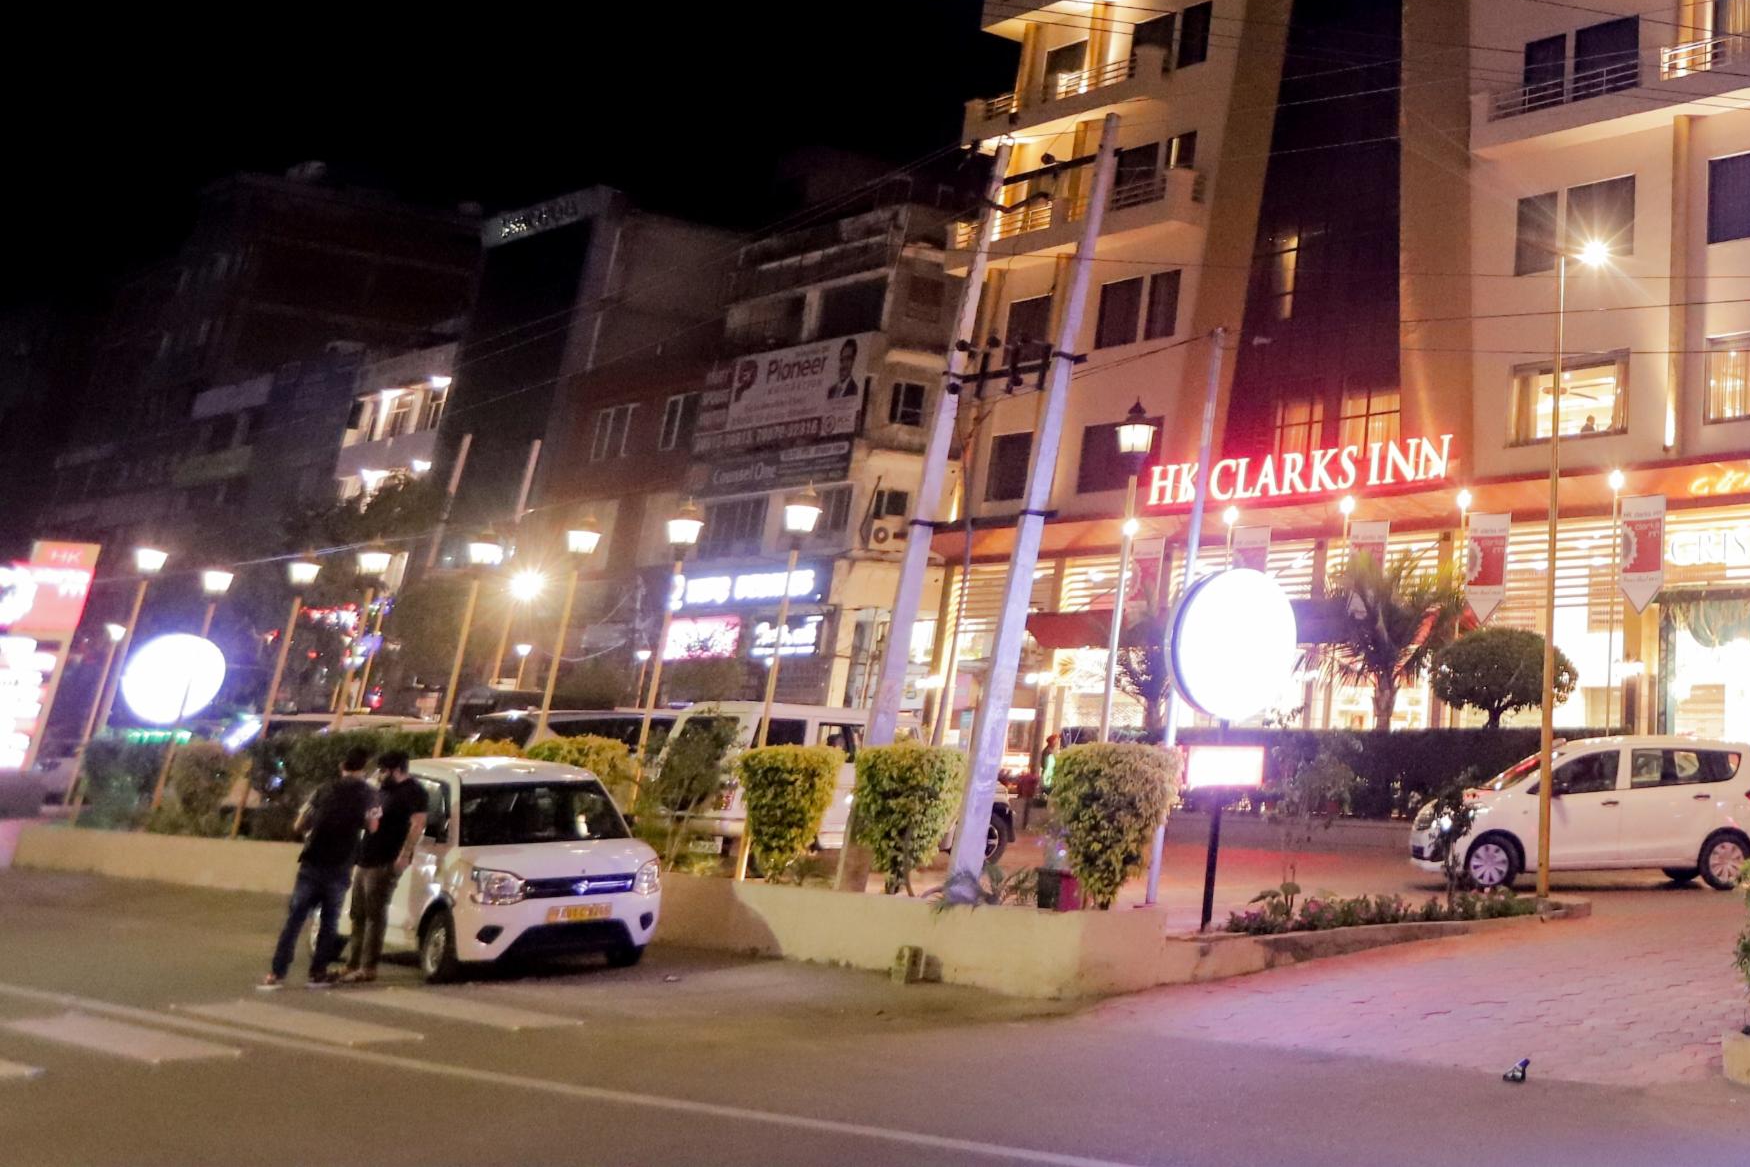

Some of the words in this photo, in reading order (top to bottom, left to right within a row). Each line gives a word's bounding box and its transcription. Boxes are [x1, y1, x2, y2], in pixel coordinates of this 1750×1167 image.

[767, 356, 828, 383] Pioneer
[1209, 443, 1359, 501] CLARKS
[1366, 433, 1454, 486] INN
[50, 550, 83, 564] HK
